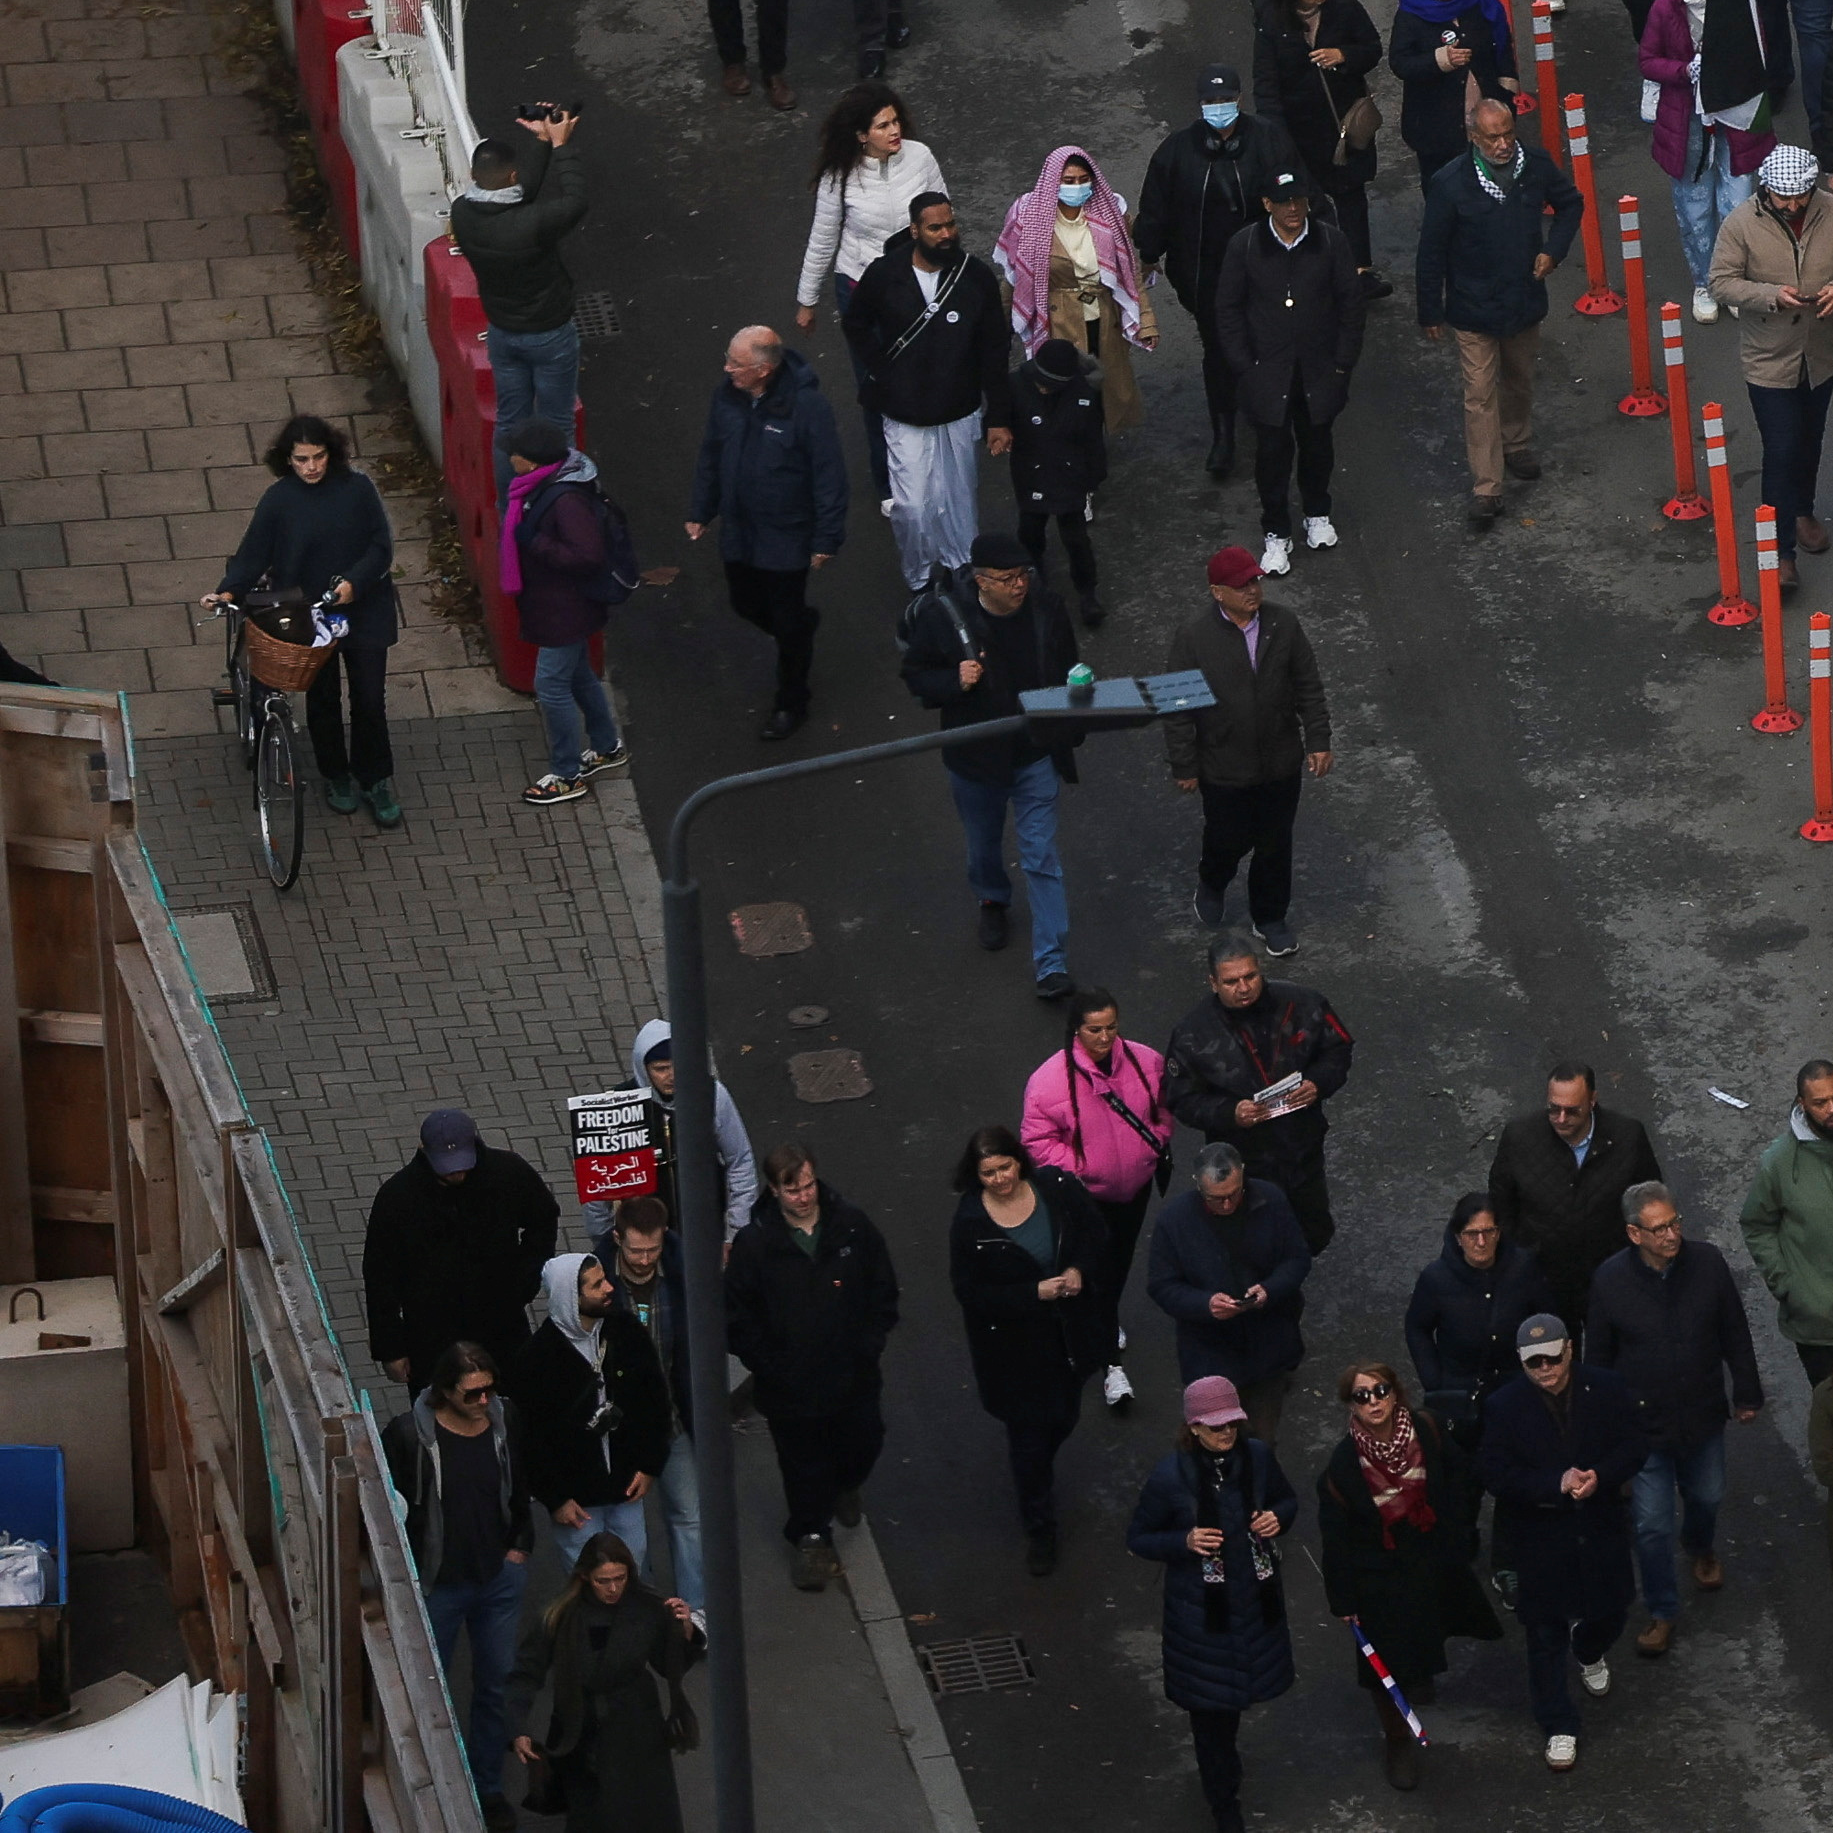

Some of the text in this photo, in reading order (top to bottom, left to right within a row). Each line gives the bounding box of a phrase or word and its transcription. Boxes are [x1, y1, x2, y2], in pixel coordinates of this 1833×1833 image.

[581, 1094, 640, 1108] Socialist Worker
[577, 1104, 645, 1129] FREEDOM
[576, 1128, 651, 1155] PALESTINE
[607, 1126, 619, 1136] for
[591, 1155, 640, 1177] الحرية
[585, 1170, 648, 1194] لفلسطين
